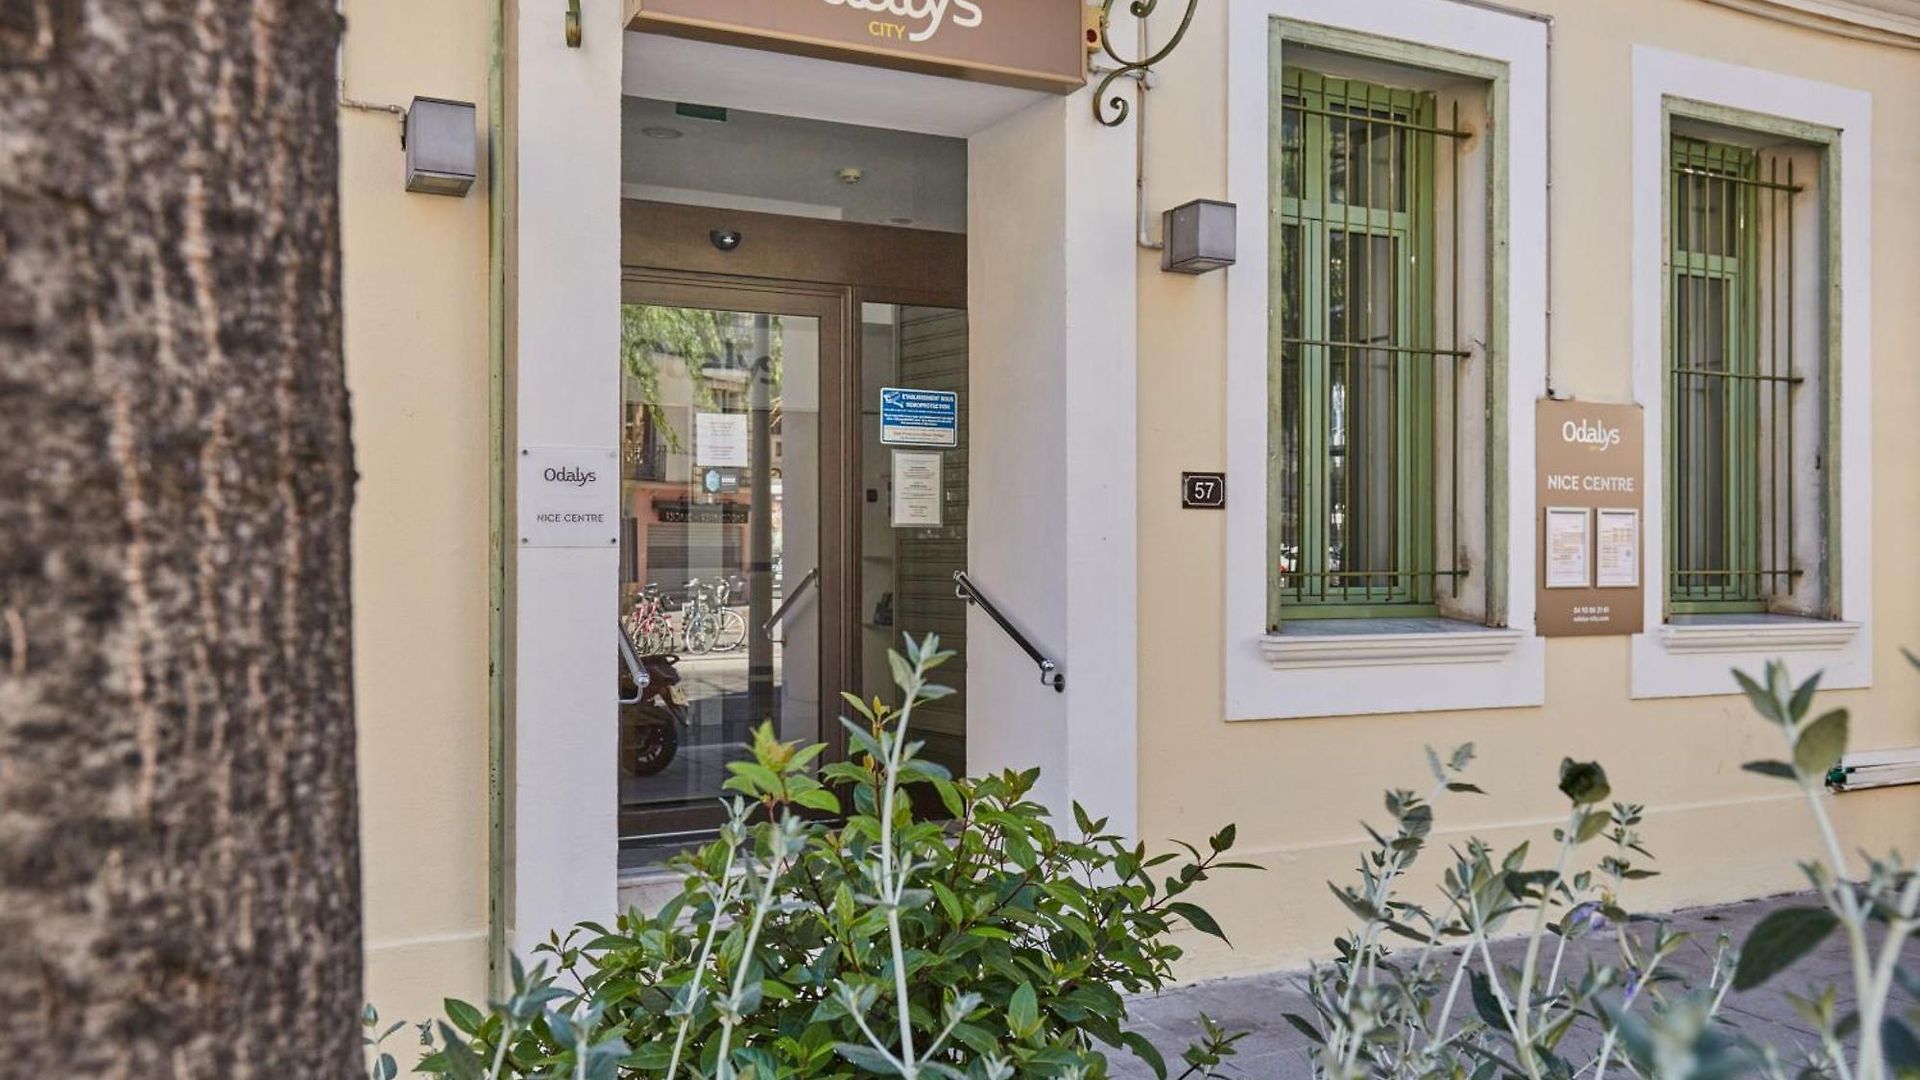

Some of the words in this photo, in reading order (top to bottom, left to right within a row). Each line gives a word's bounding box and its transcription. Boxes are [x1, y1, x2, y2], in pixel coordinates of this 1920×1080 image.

[868, 21, 906, 39] CITY
[1562, 419, 1621, 451] Odalys
[543, 466, 597, 487] Odalys
[1548, 475, 1579, 490] NICE
[1583, 476, 1635, 492] CENTRE
[1194, 482, 1215, 499] 57
[537, 513, 561, 522] NICE
[563, 513, 605, 523] CENTRE
